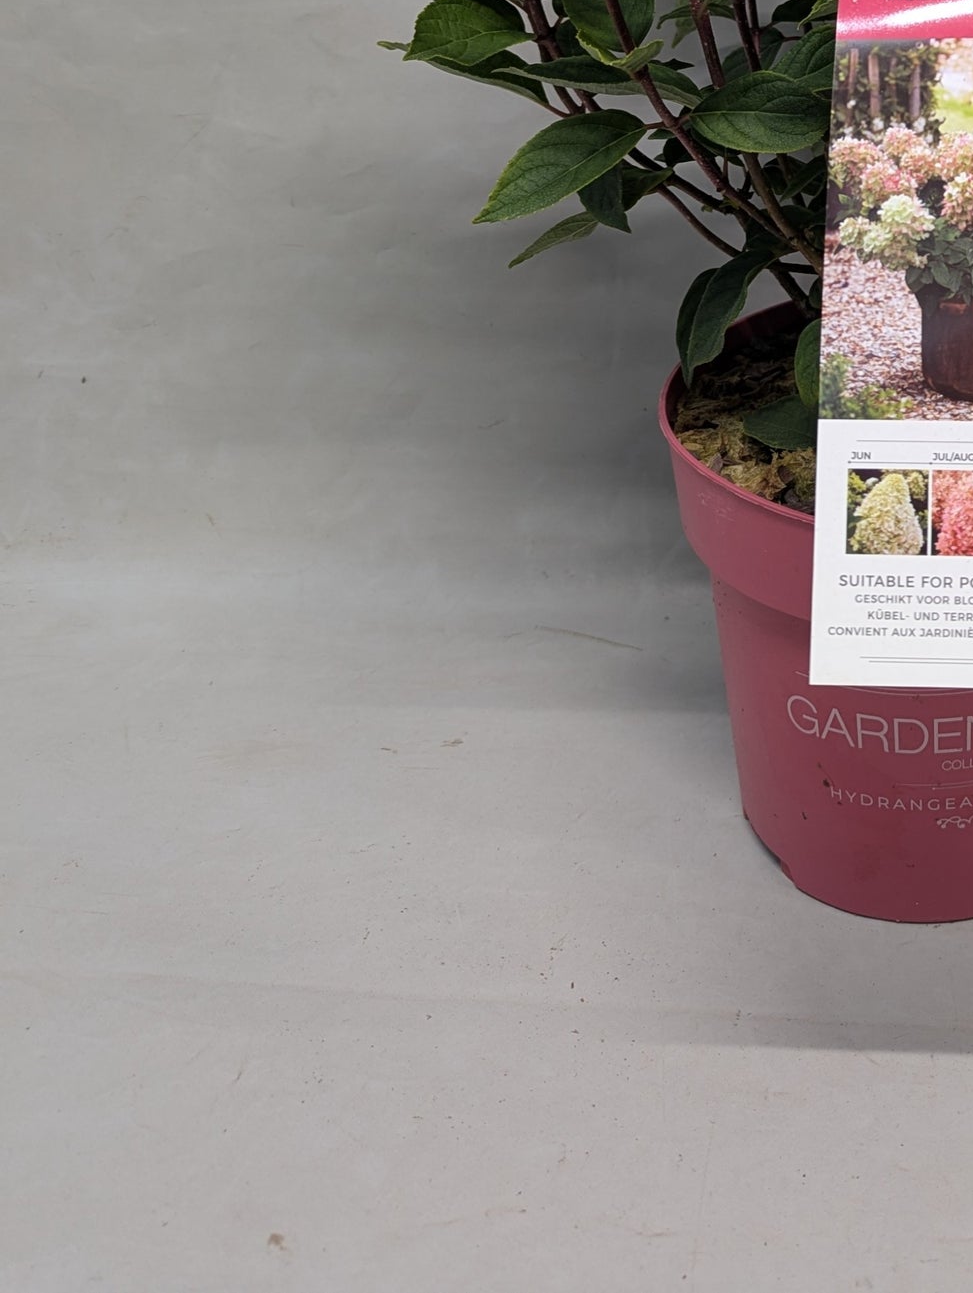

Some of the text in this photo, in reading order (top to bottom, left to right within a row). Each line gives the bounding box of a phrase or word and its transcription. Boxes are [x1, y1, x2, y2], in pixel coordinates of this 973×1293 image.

[850, 451, 872, 461] JUN
[838, 574, 916, 589] SUITABLE
[921, 575, 954, 589] FOR
[854, 594, 913, 605] GESCHIKT
[916, 595, 951, 606] VOOR
[867, 608, 910, 621] KÜBEL-
[913, 611, 940, 622] UND
[827, 626, 888, 637] CONVIENT
[891, 627, 917, 638] AUX
[829, 785, 973, 812] HYDRANGEA
